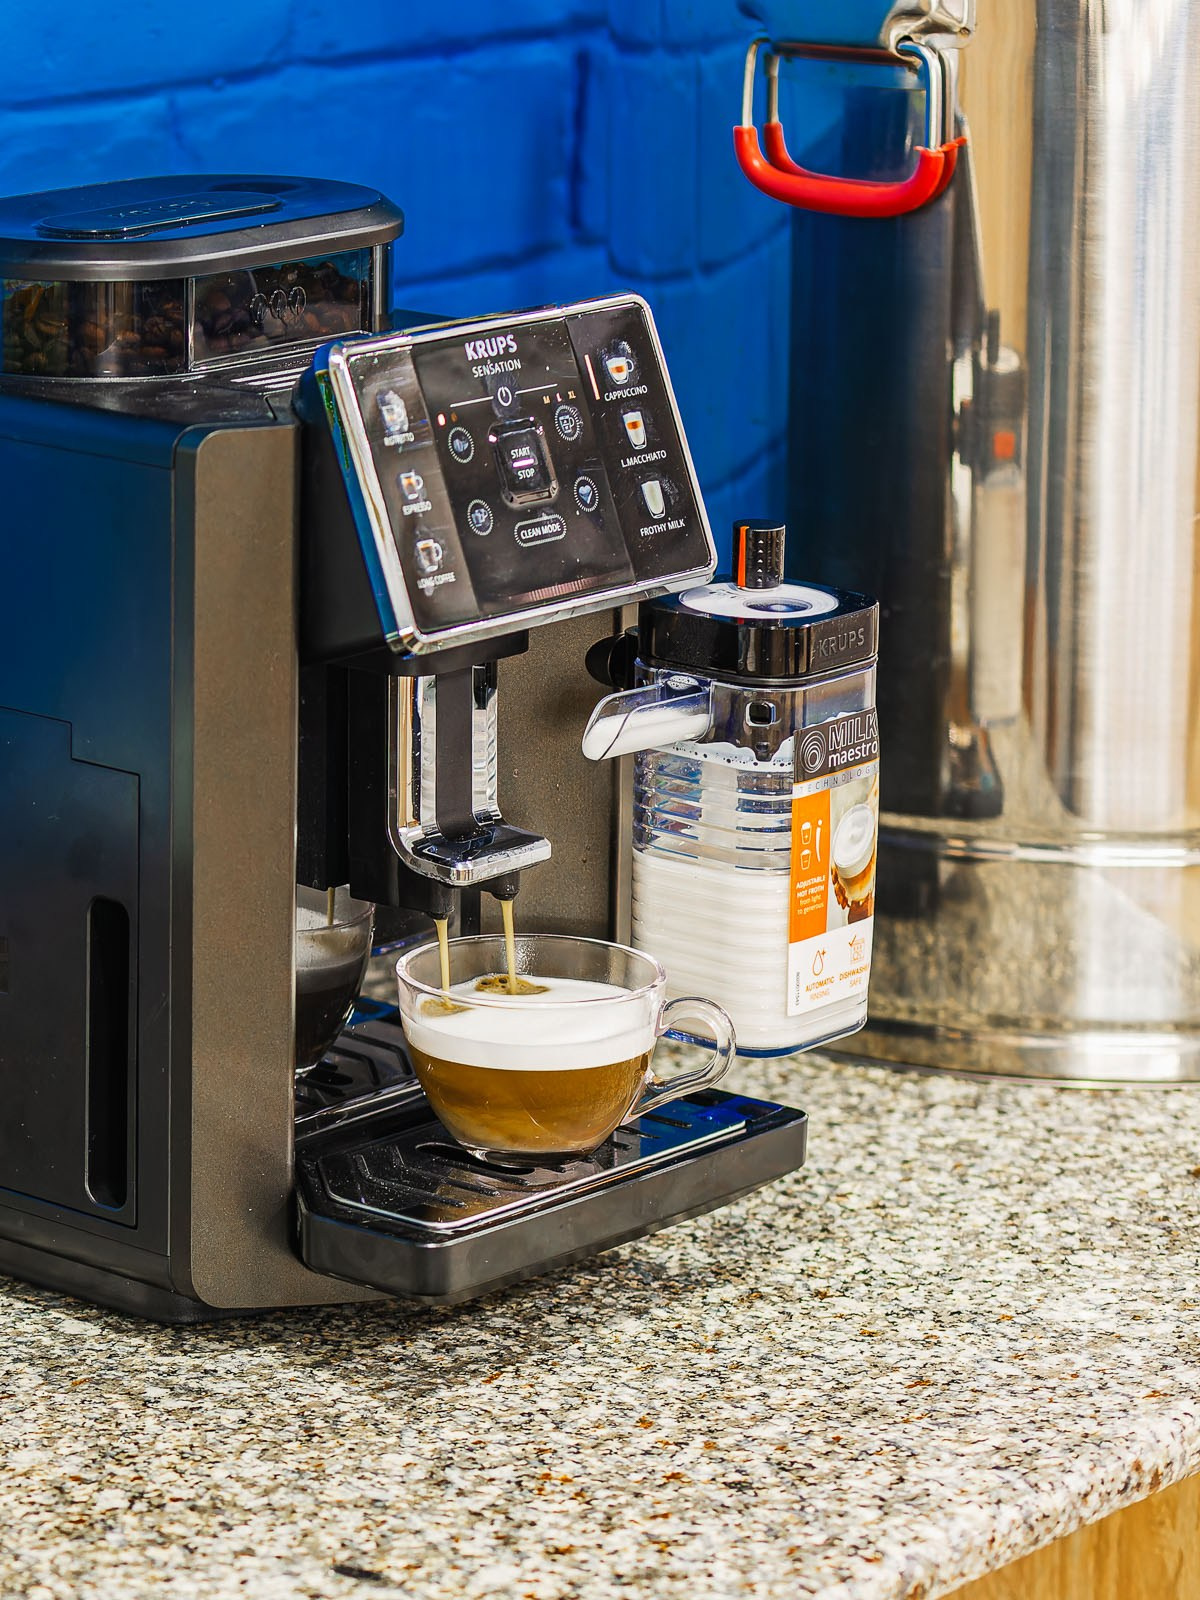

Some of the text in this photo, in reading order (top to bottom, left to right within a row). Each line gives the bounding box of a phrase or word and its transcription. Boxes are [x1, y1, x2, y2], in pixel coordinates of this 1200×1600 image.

[464, 334, 518, 361] KRUPS
[472, 359, 522, 378] SENSATION
[556, 392, 563, 403] L
[604, 384, 648, 402] CAPPUCCINO
[510, 446, 531, 459] START
[620, 450, 668, 468] L.MACCHIATO
[517, 468, 536, 480] STOP
[520, 522, 562, 540] CLEAN MODE
[640, 518, 686, 537] FROTHY MILK
[818, 627, 865, 658] KRUPS
[828, 711, 879, 752] MILK
[828, 739, 878, 768] maestro
[795, 874, 826, 890] ADJUSTABLE
[805, 976, 835, 993] AUTOMATIC
